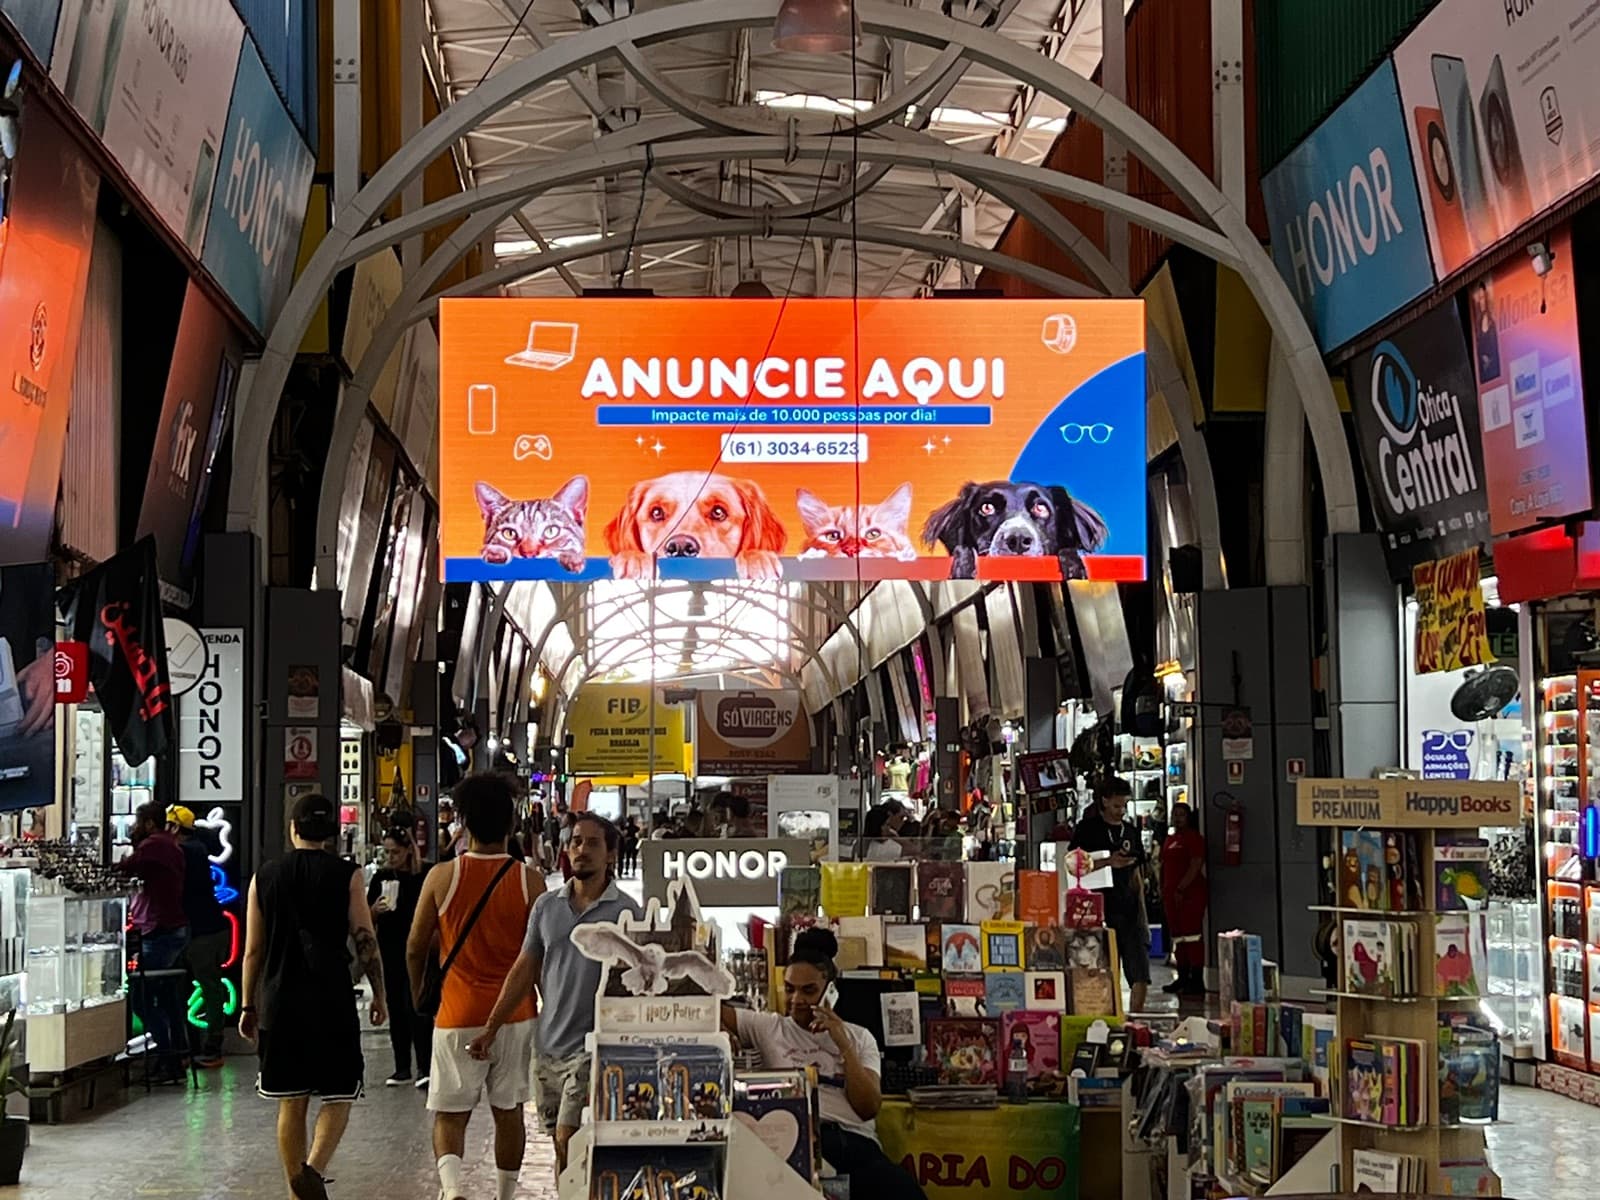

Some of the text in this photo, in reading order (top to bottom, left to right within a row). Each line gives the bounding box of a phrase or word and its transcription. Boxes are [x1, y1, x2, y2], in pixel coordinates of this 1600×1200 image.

[1286, 147, 1403, 303] HONOR
[580, 357, 1005, 405] ANUNCIE AQUI
[1417, 379, 1453, 427] Ótica
[651, 409, 937, 423] Impacte mais de 10.000 pessoas por dia!
[729, 440, 860, 457] (61) 3034-6523
[1379, 395, 1478, 514] Central
[197, 654, 222, 790] HONOR
[722, 707, 793, 728] SÓ VIAGENS
[625, 727, 667, 736] IMPORTDOS
[1424, 753, 1458, 762] ÓCULOS
[1424, 762, 1469, 771] ARMAÇÕES
[1312, 801, 1382, 820] PREMIUM
[1406, 792, 1512, 815] Happy Books
[663, 850, 788, 879] HONOR
[1008, 1154, 1067, 1190] DO
